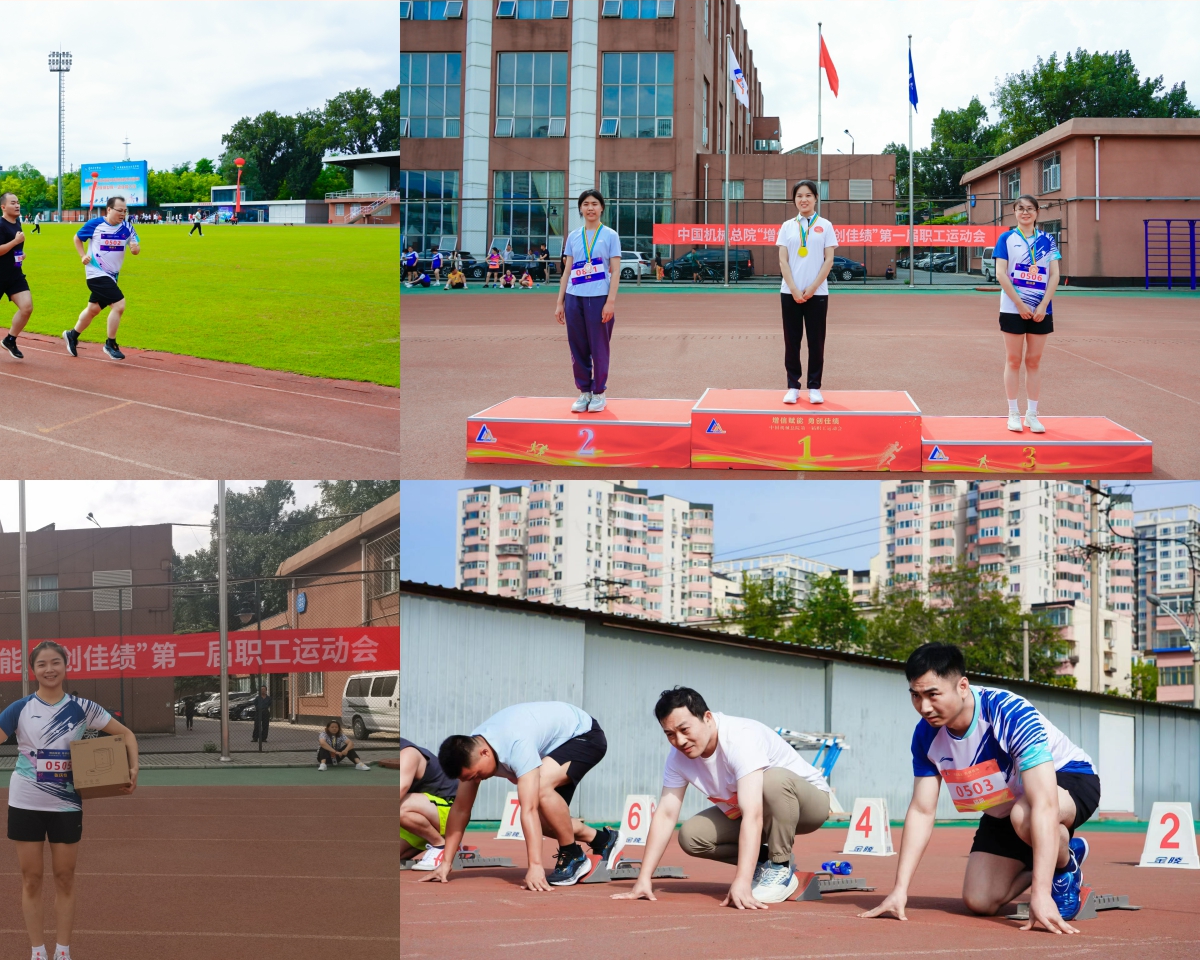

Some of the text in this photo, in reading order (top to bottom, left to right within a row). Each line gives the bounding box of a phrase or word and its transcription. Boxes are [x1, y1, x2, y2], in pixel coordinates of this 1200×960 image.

[677, 226, 780, 243] 中国机械总院“增
[575, 266, 598, 276] 081
[1020, 272, 1043, 282] 0506
[579, 428, 595, 455] 2
[798, 435, 816, 462] 1
[1022, 447, 1036, 468] 3
[955, 778, 994, 797] 0503
[510, 799, 520, 826] 7
[627, 802, 641, 830] 6
[855, 806, 872, 838] 4
[1159, 812, 1180, 848] 2
[1154, 856, 1183, 864] 金陵
